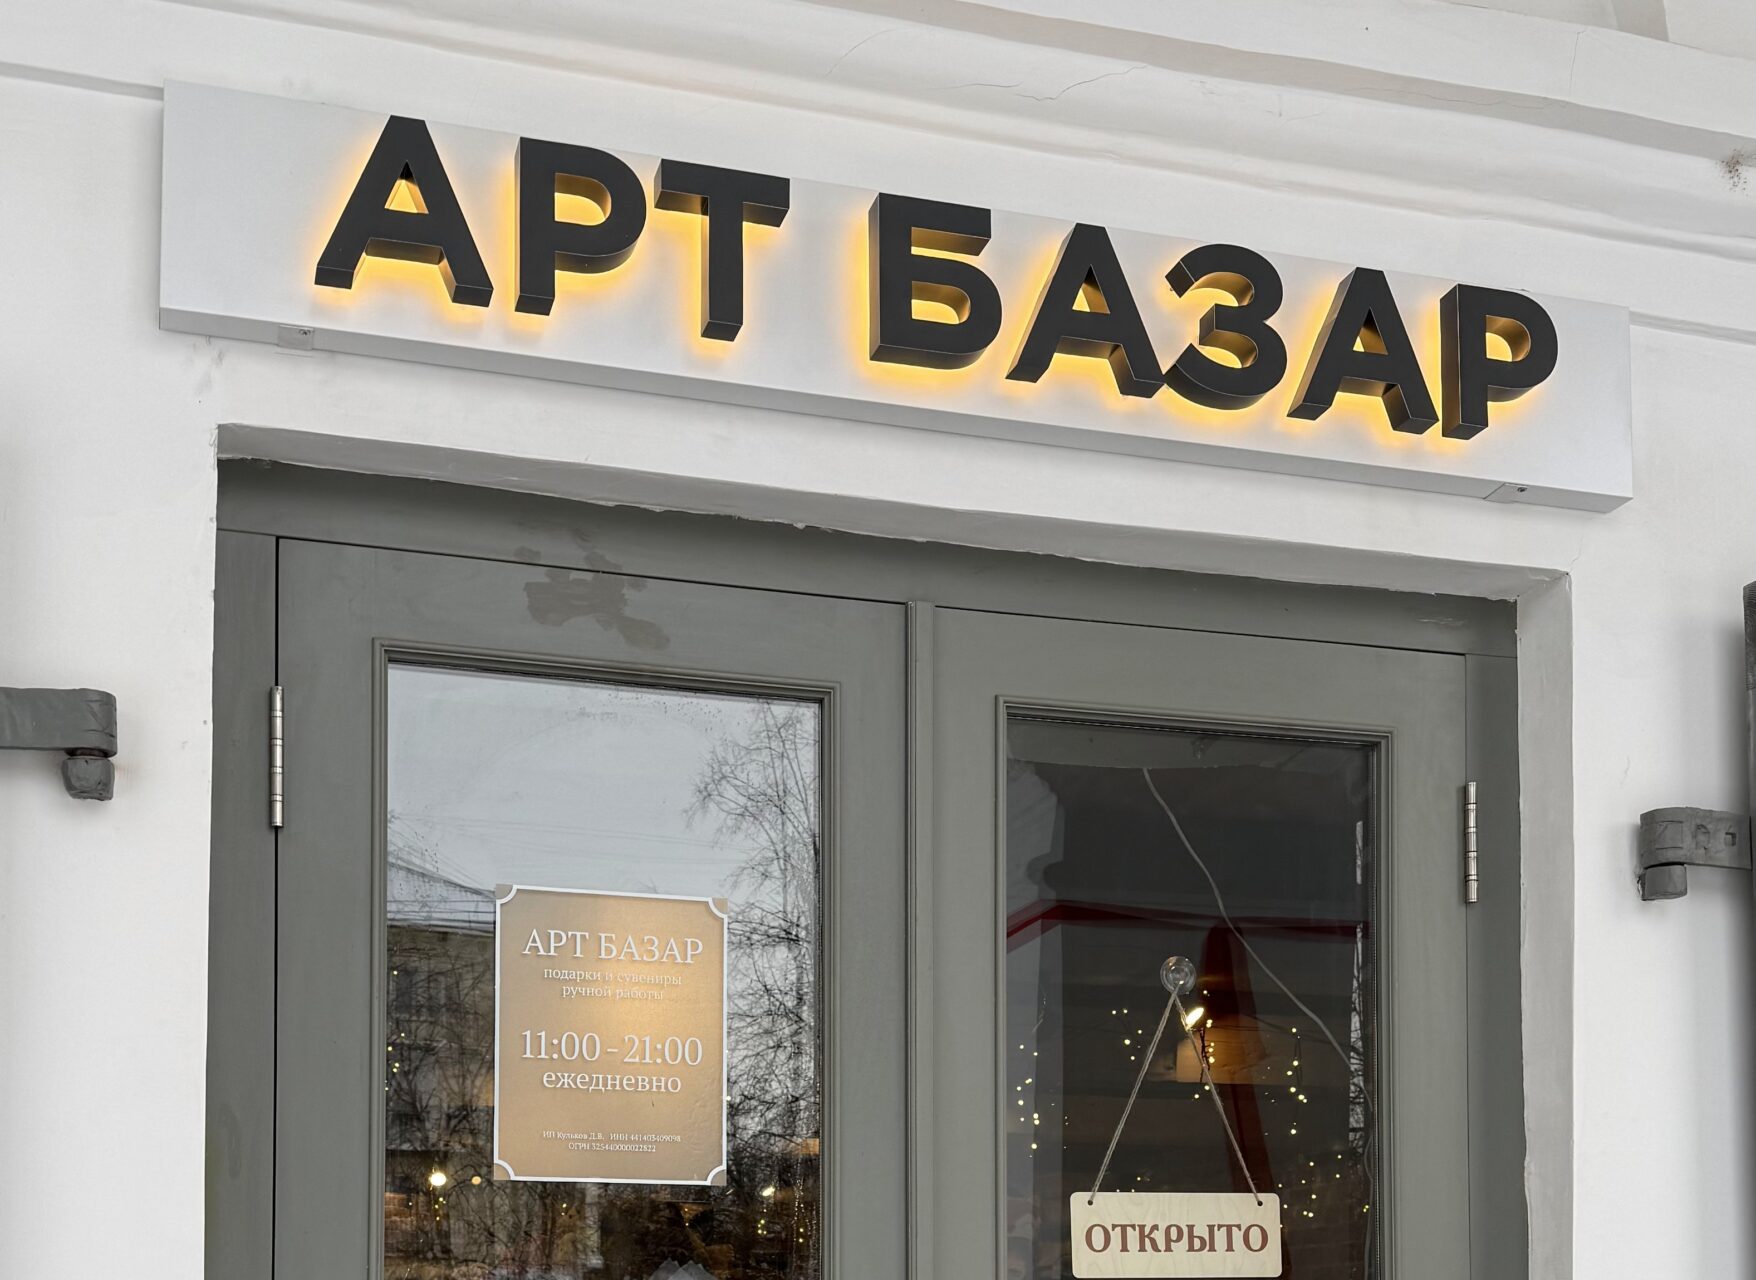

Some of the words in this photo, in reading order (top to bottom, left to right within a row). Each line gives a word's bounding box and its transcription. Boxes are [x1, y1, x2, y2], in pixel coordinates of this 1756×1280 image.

[314, 114, 791, 342] АРТ
[868, 190, 1559, 440] БАЗАР
[522, 928, 589, 958] АРТ
[598, 933, 703, 964] БАЗАР
[543, 968, 601, 983] подарки
[605, 971, 613, 981] и
[616, 972, 682, 987] сувениры
[562, 985, 612, 998] ручной
[616, 986, 664, 1000] работы
[542, 1071, 682, 1093] ежедневно
[543, 1130, 555, 1138] ИП
[610, 1133, 628, 1141] ИНН
[568, 1142, 590, 1151] ОГРН
[1084, 1223, 1269, 1253] ОТКРЫТО
